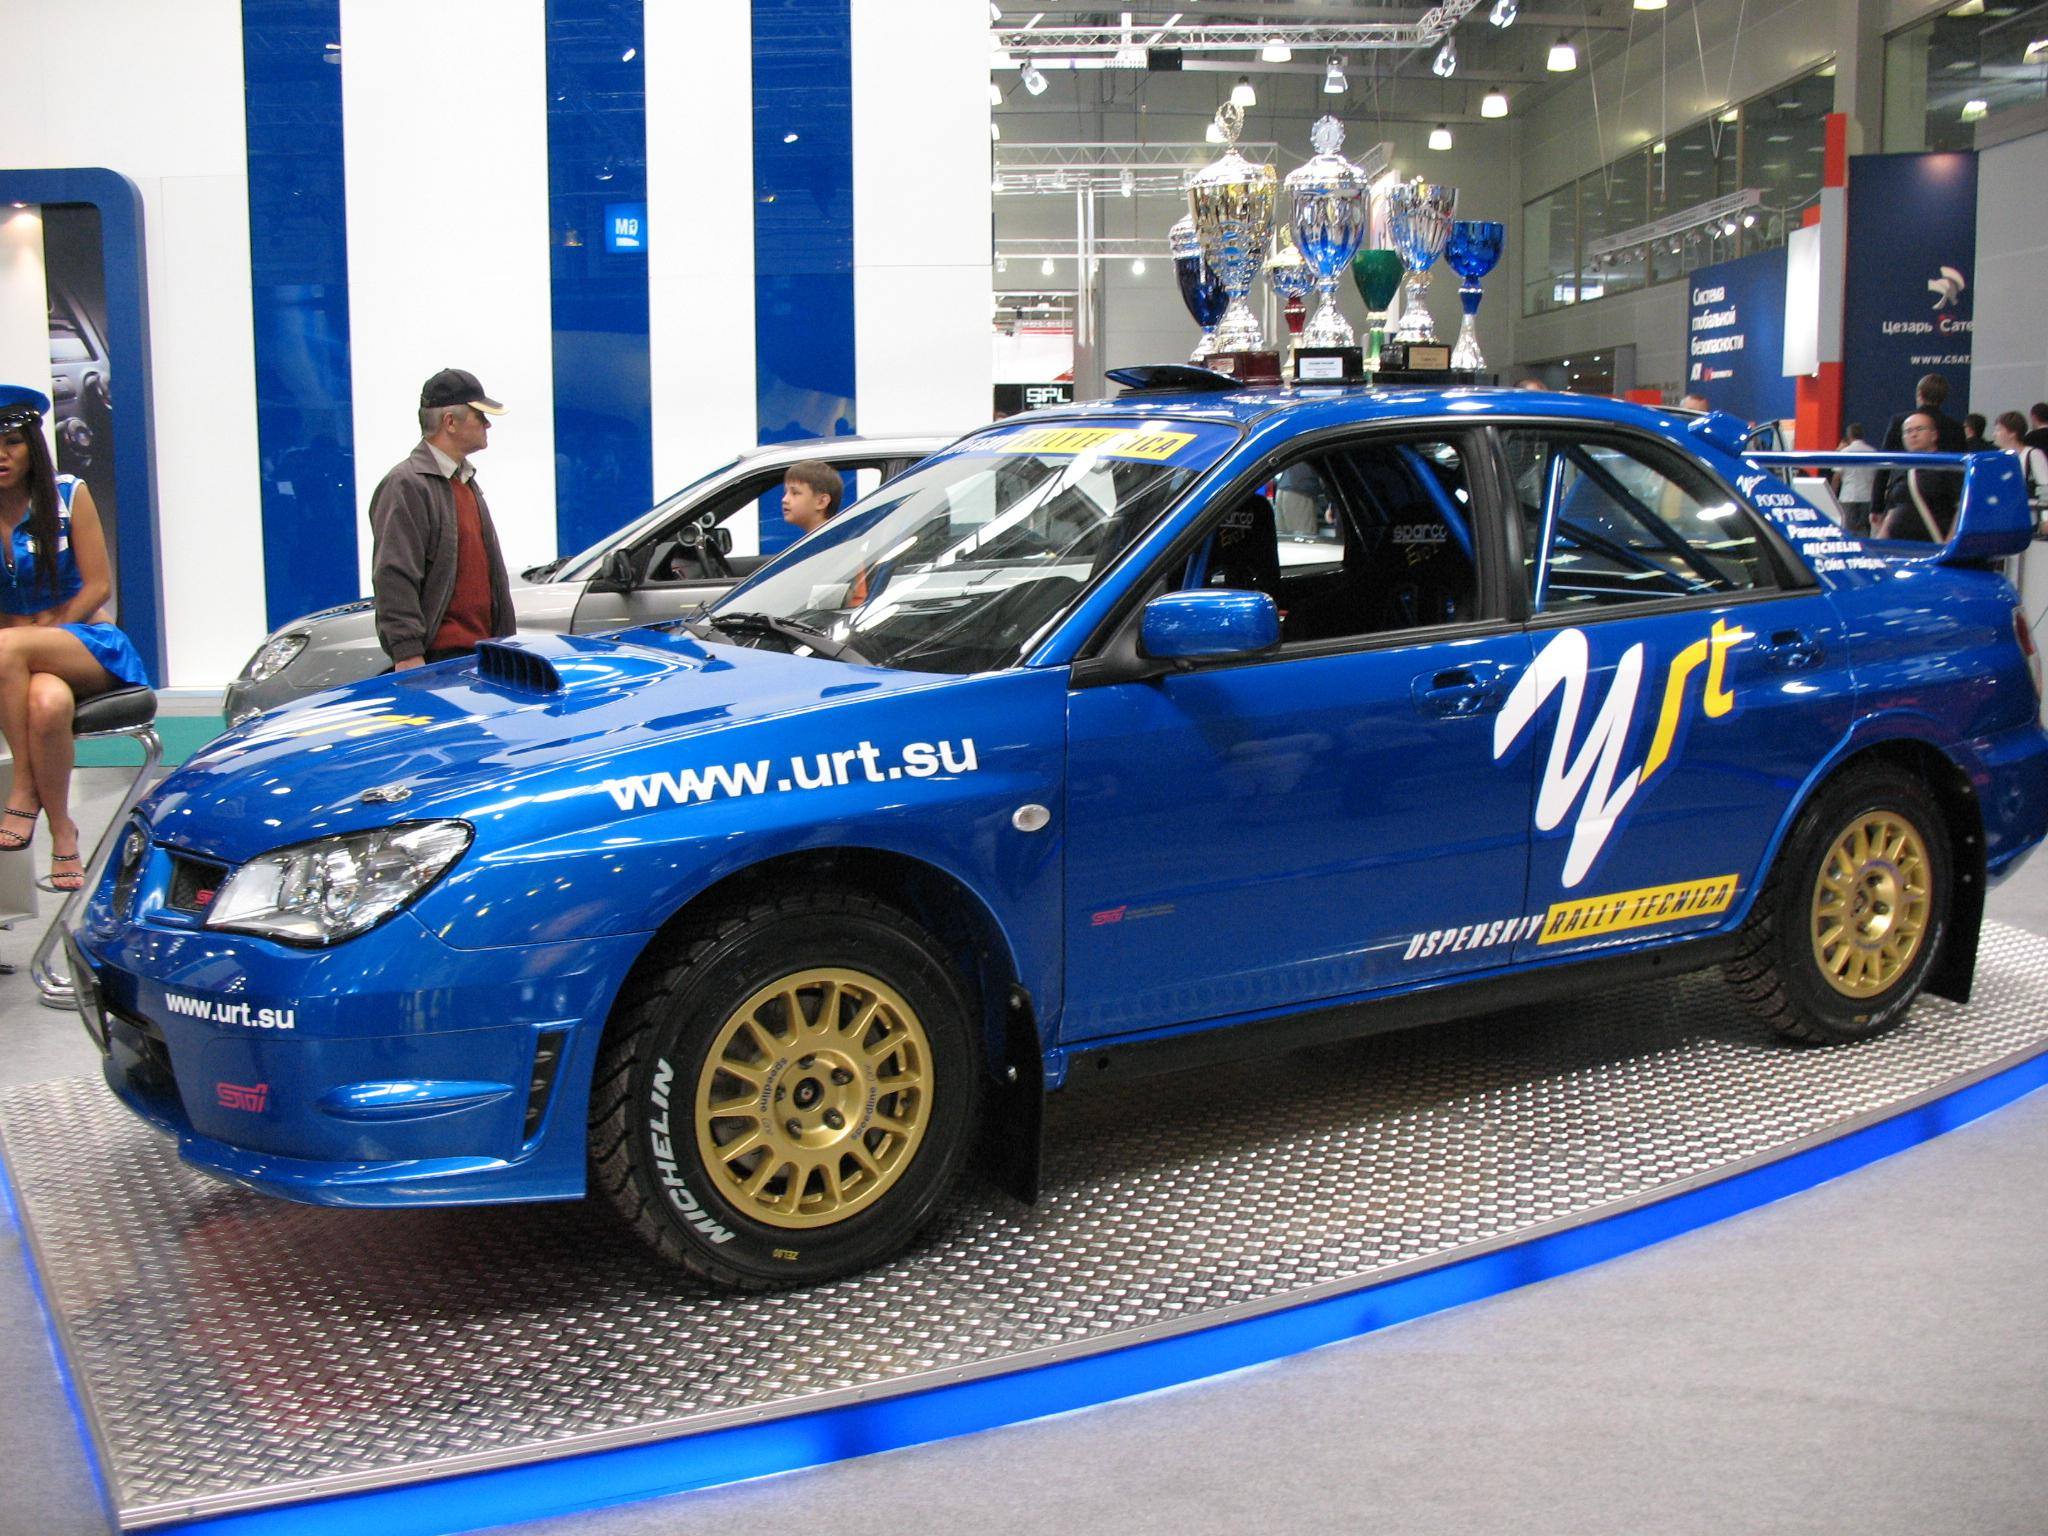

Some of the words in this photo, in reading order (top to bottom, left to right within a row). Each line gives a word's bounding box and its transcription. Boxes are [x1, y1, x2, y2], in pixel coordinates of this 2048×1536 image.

[1882, 320, 1933, 336] Цезарь
[1026, 388, 1071, 403] SPL
[1070, 432, 1180, 454] TEICA
[1803, 542, 1863, 555] MICHELIN
[604, 738, 979, 811] www.urt.su
[1403, 914, 1545, 960] USPENSKIY
[1547, 902, 1624, 935] RALLY
[1629, 883, 1730, 923] TECNICA
[165, 992, 295, 1029] www.urt.su
[650, 1057, 736, 1244] MICHELIN
